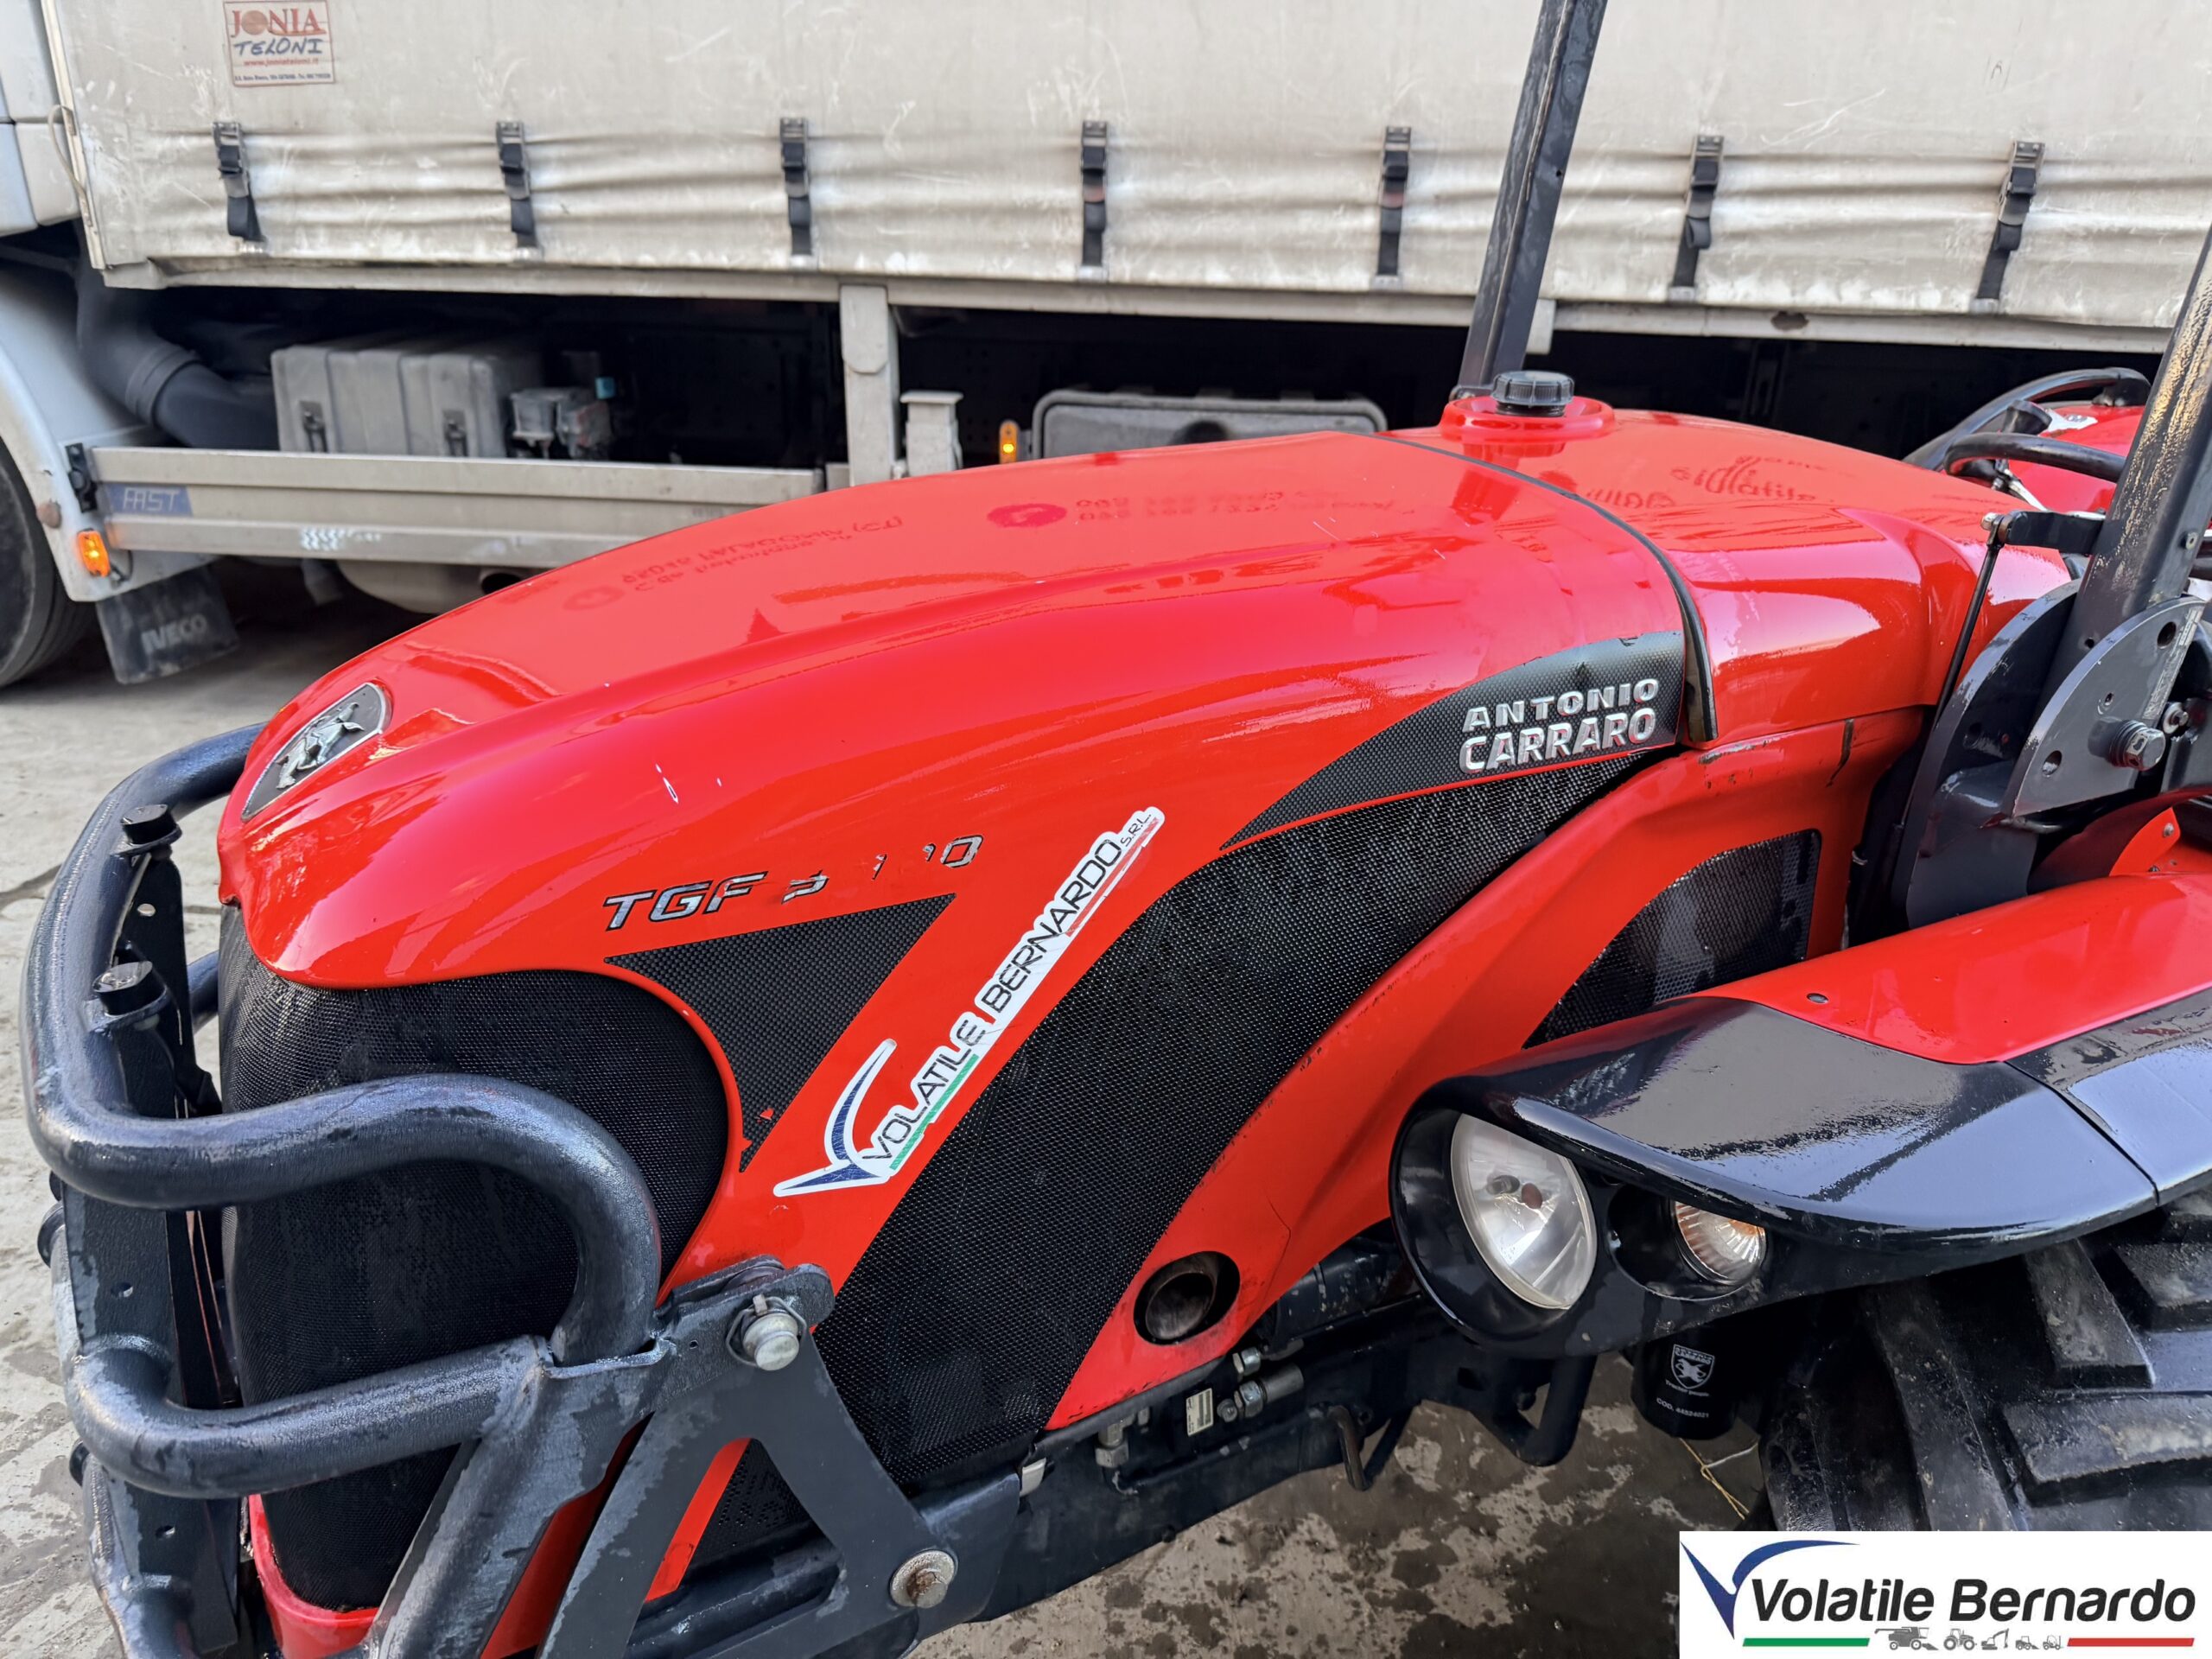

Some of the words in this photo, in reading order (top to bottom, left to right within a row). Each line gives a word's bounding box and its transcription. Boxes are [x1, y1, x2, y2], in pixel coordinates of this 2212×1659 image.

[231, 9, 321, 37] JONIA
[233, 37, 323, 56] TELONI
[123, 486, 181, 512] FAST
[141, 613, 207, 655] IVECO
[1462, 678, 1659, 733] ANTONIO
[1459, 708, 1656, 774] CARRARO
[603, 871, 768, 931] TGF
[861, 1019, 986, 1160] VOLATILE
[981, 838, 1122, 1014] BERNARDO
